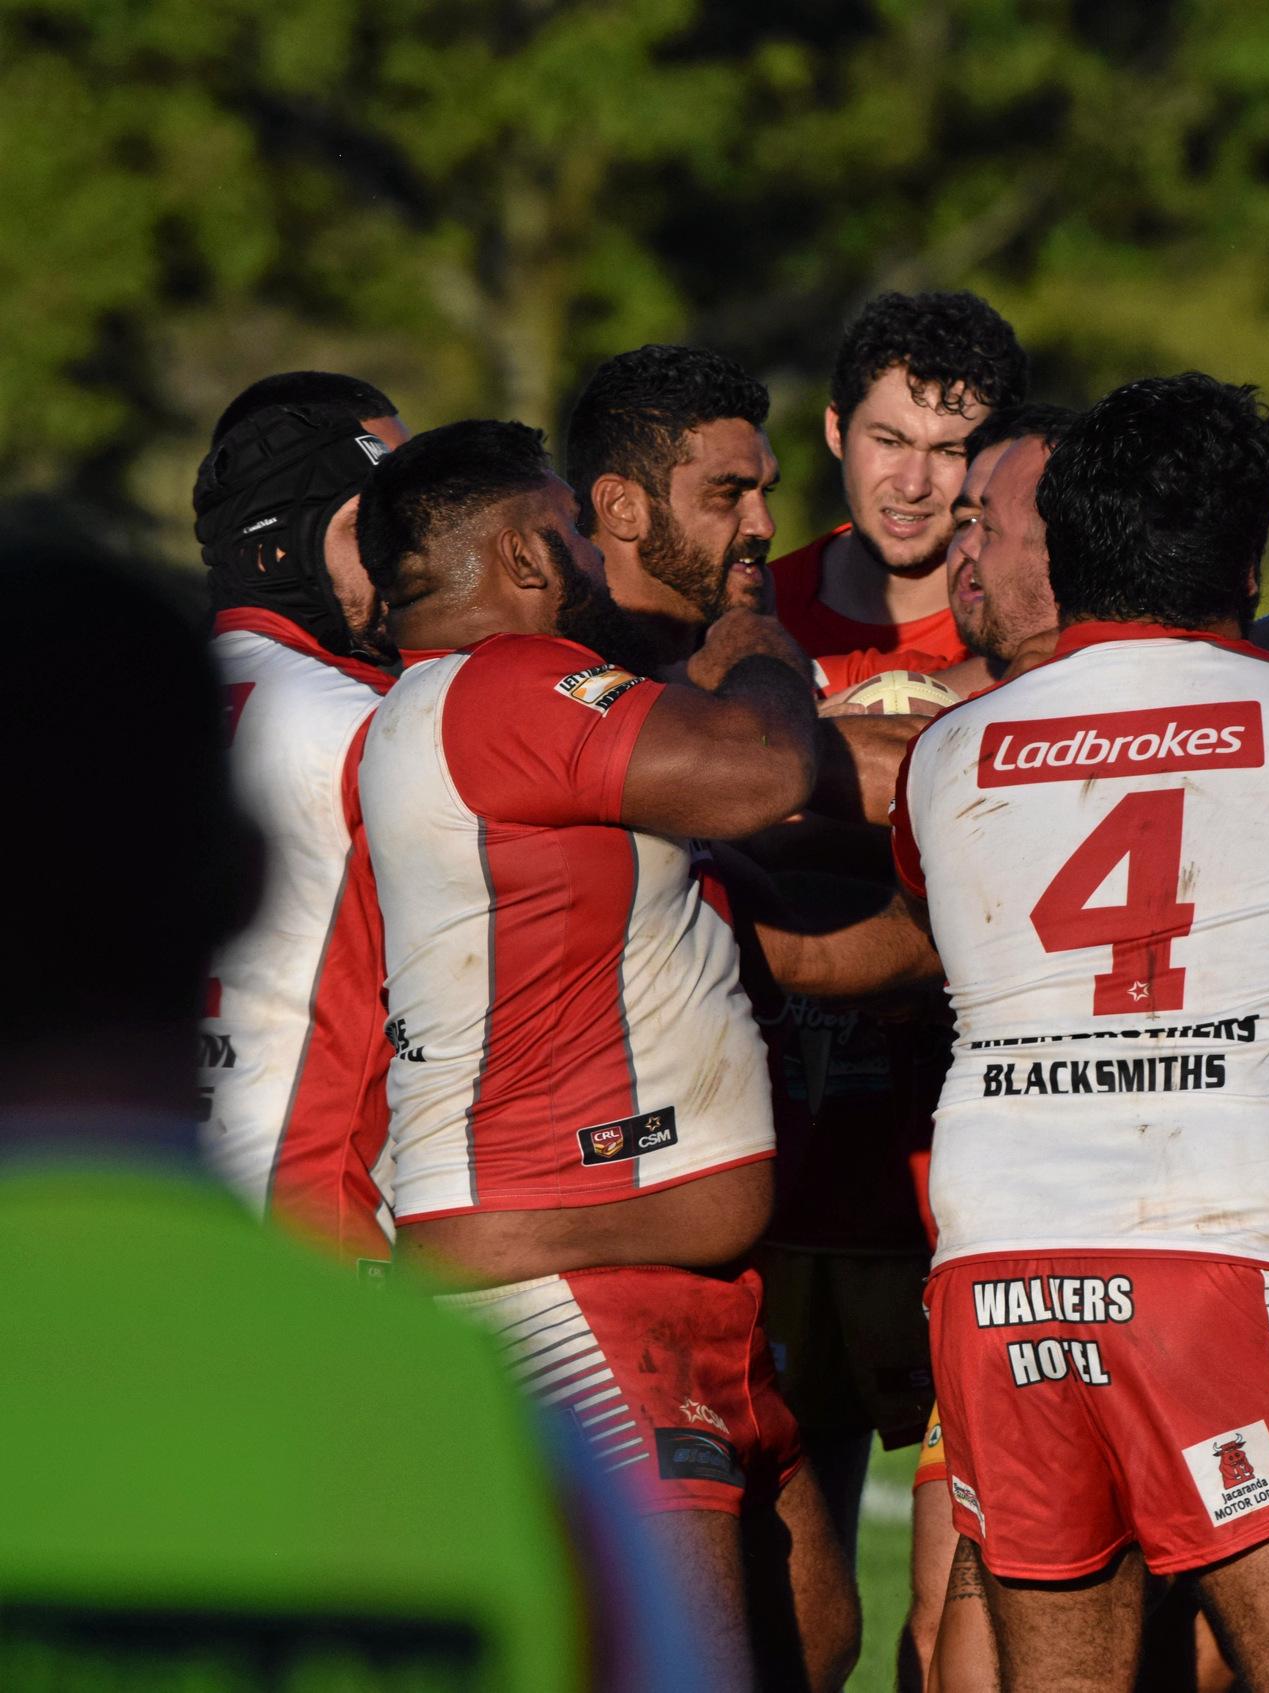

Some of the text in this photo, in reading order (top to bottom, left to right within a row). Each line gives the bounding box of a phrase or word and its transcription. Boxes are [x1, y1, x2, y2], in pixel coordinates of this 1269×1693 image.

[993, 722, 1246, 772] Ladbrokes
[1029, 787, 1195, 1016] 4
[983, 1054, 1226, 1097] BLACKSMITHS
[594, 1130, 620, 1142] CRL
[638, 1129, 672, 1148] CSM
[1007, 1336, 1112, 1388] HOEL
[1214, 1497, 1253, 1521] MOTOR
[1222, 1478, 1269, 1505] Jacaranda
